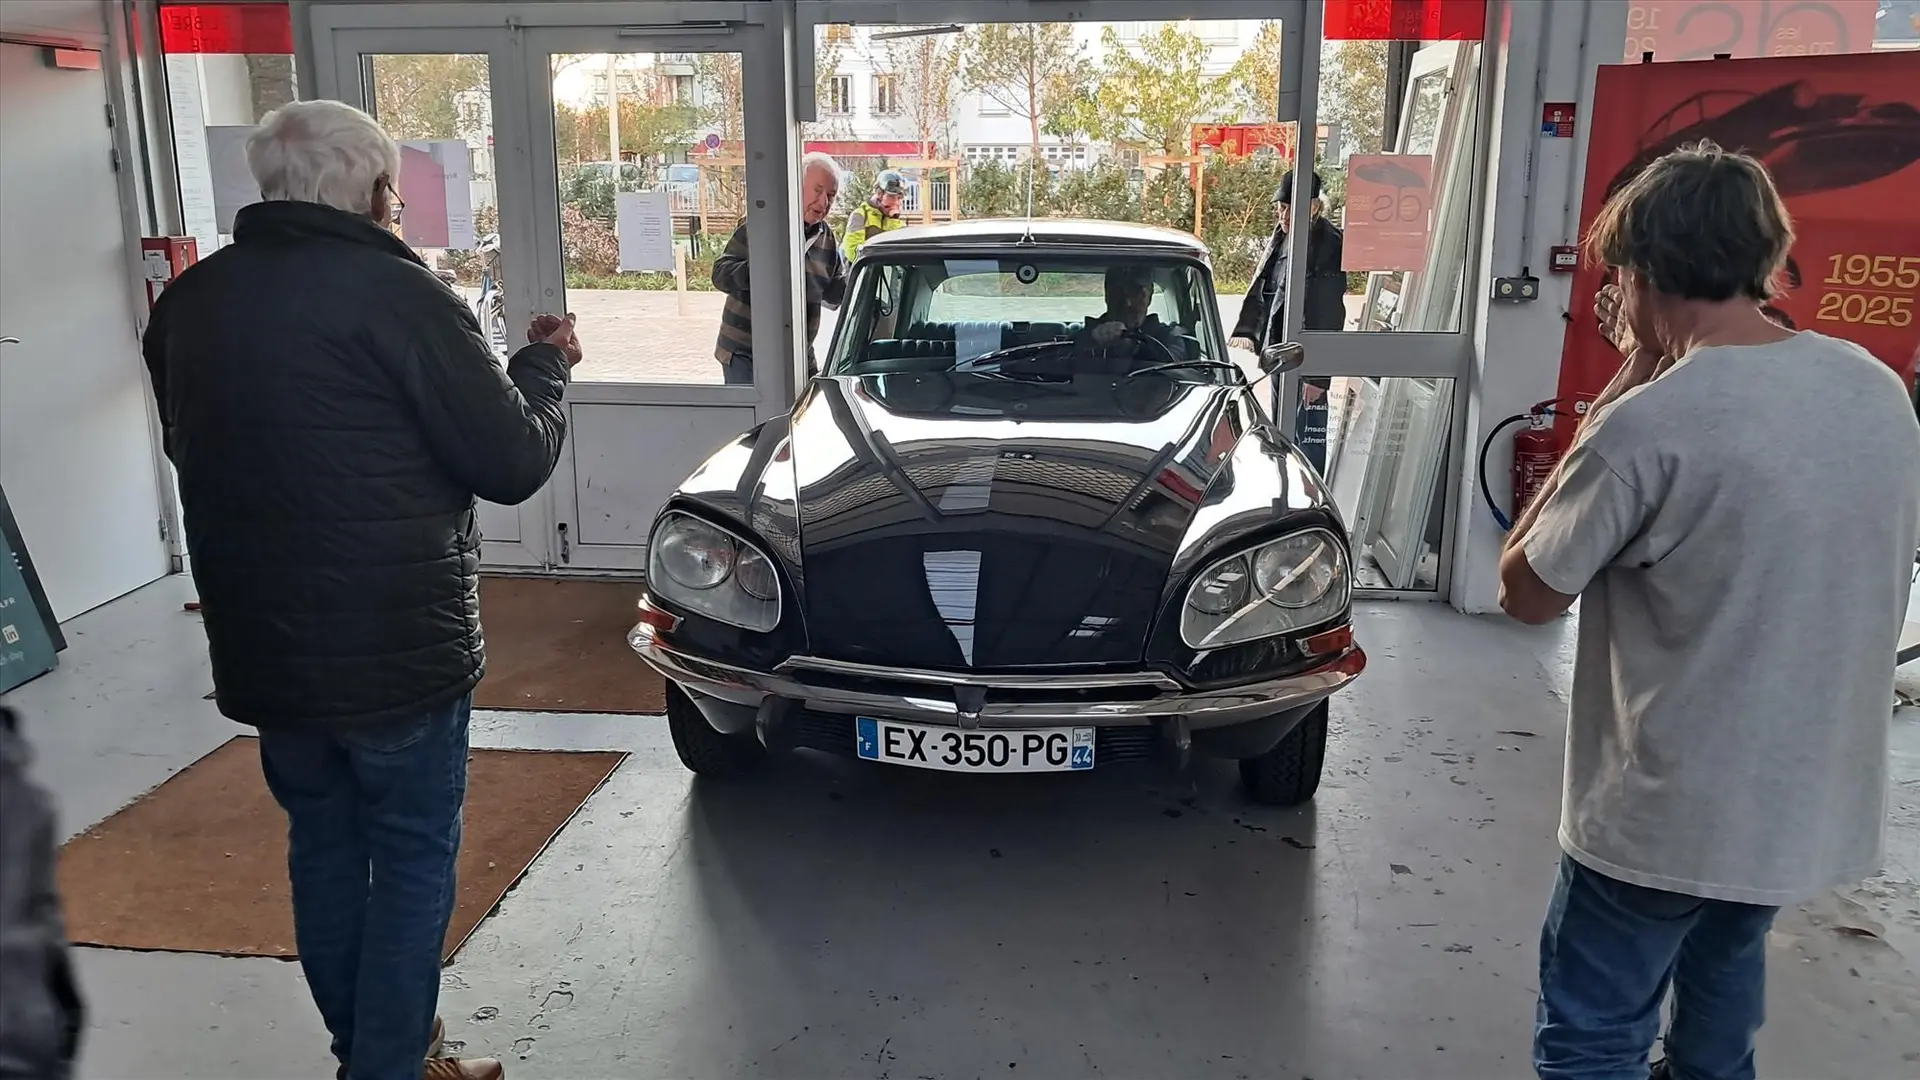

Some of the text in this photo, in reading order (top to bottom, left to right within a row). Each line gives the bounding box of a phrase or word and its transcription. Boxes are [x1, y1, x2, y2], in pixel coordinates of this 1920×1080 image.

[1823, 254, 1920, 289] 1955
[1816, 292, 1914, 327] 2025
[865, 741, 872, 751] F
[884, 726, 1068, 767] EX-350-PG
[1072, 749, 1092, 765] 44
